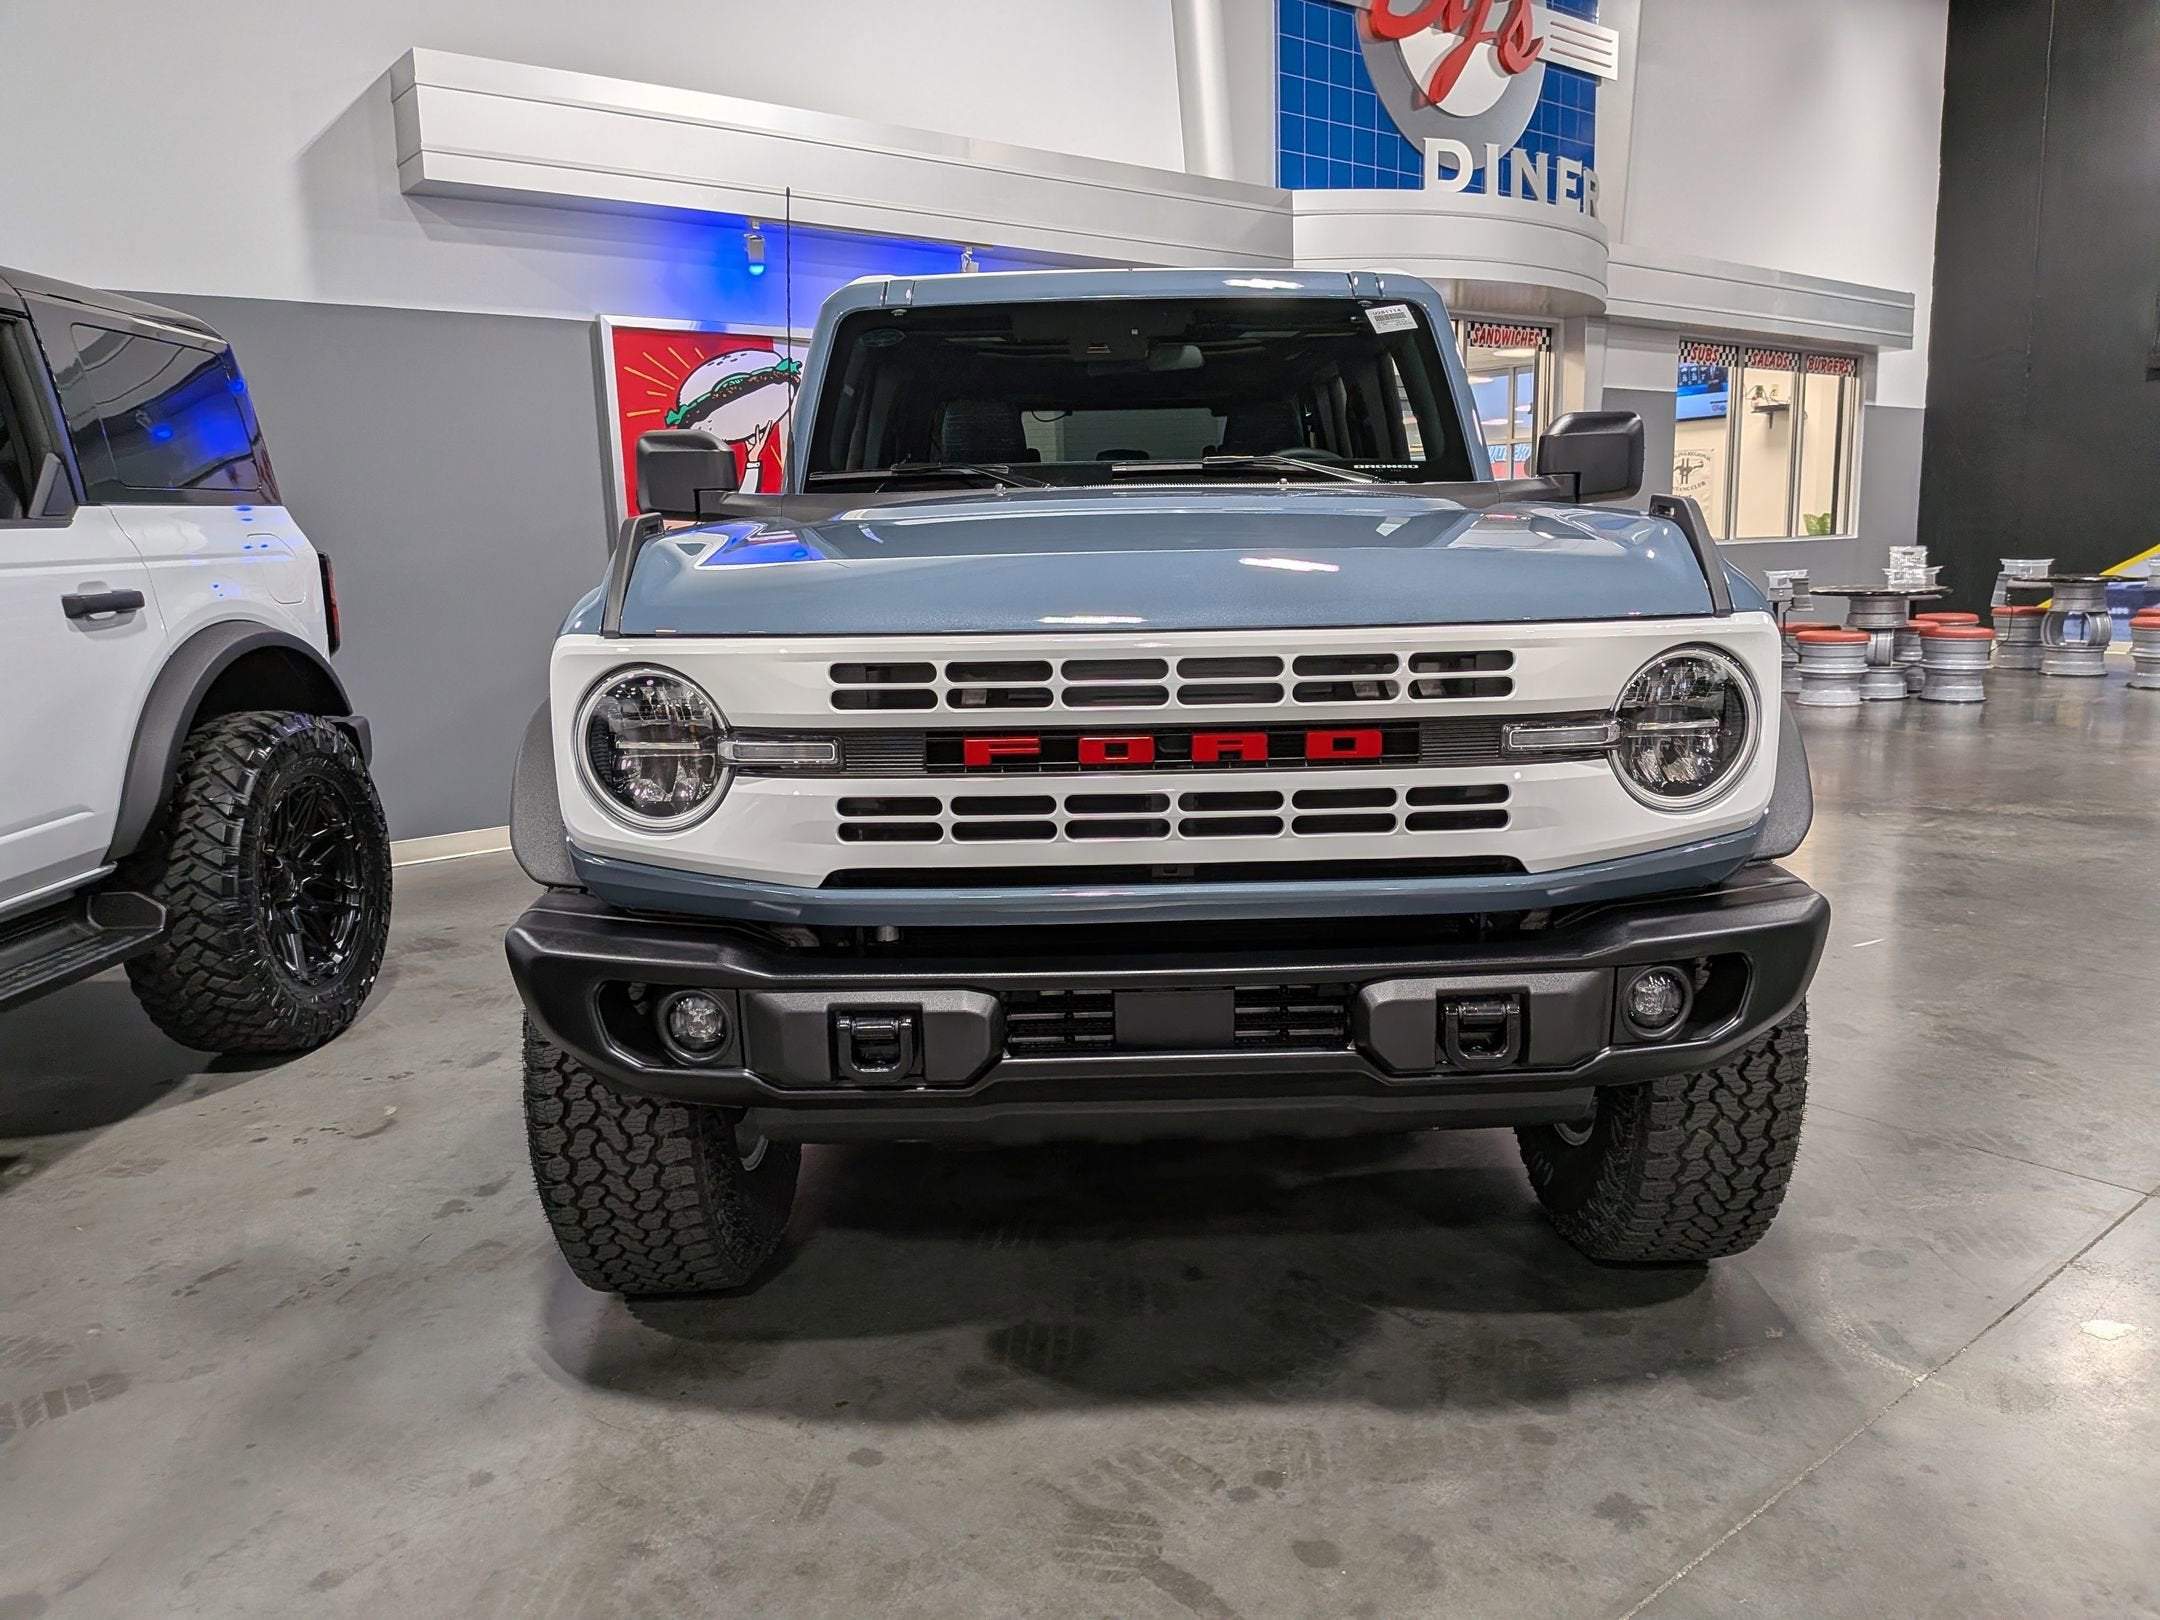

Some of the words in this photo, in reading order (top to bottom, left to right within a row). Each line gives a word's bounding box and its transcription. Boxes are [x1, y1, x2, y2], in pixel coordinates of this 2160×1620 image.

[1423, 137, 1600, 219] DINER
[1472, 326, 1541, 348] SANDWICHES
[1690, 346, 1720, 363] SUBS
[1751, 352, 1790, 369] SALADS
[1807, 357, 1850, 374] BURGERS
[963, 730, 1384, 767] FORD
